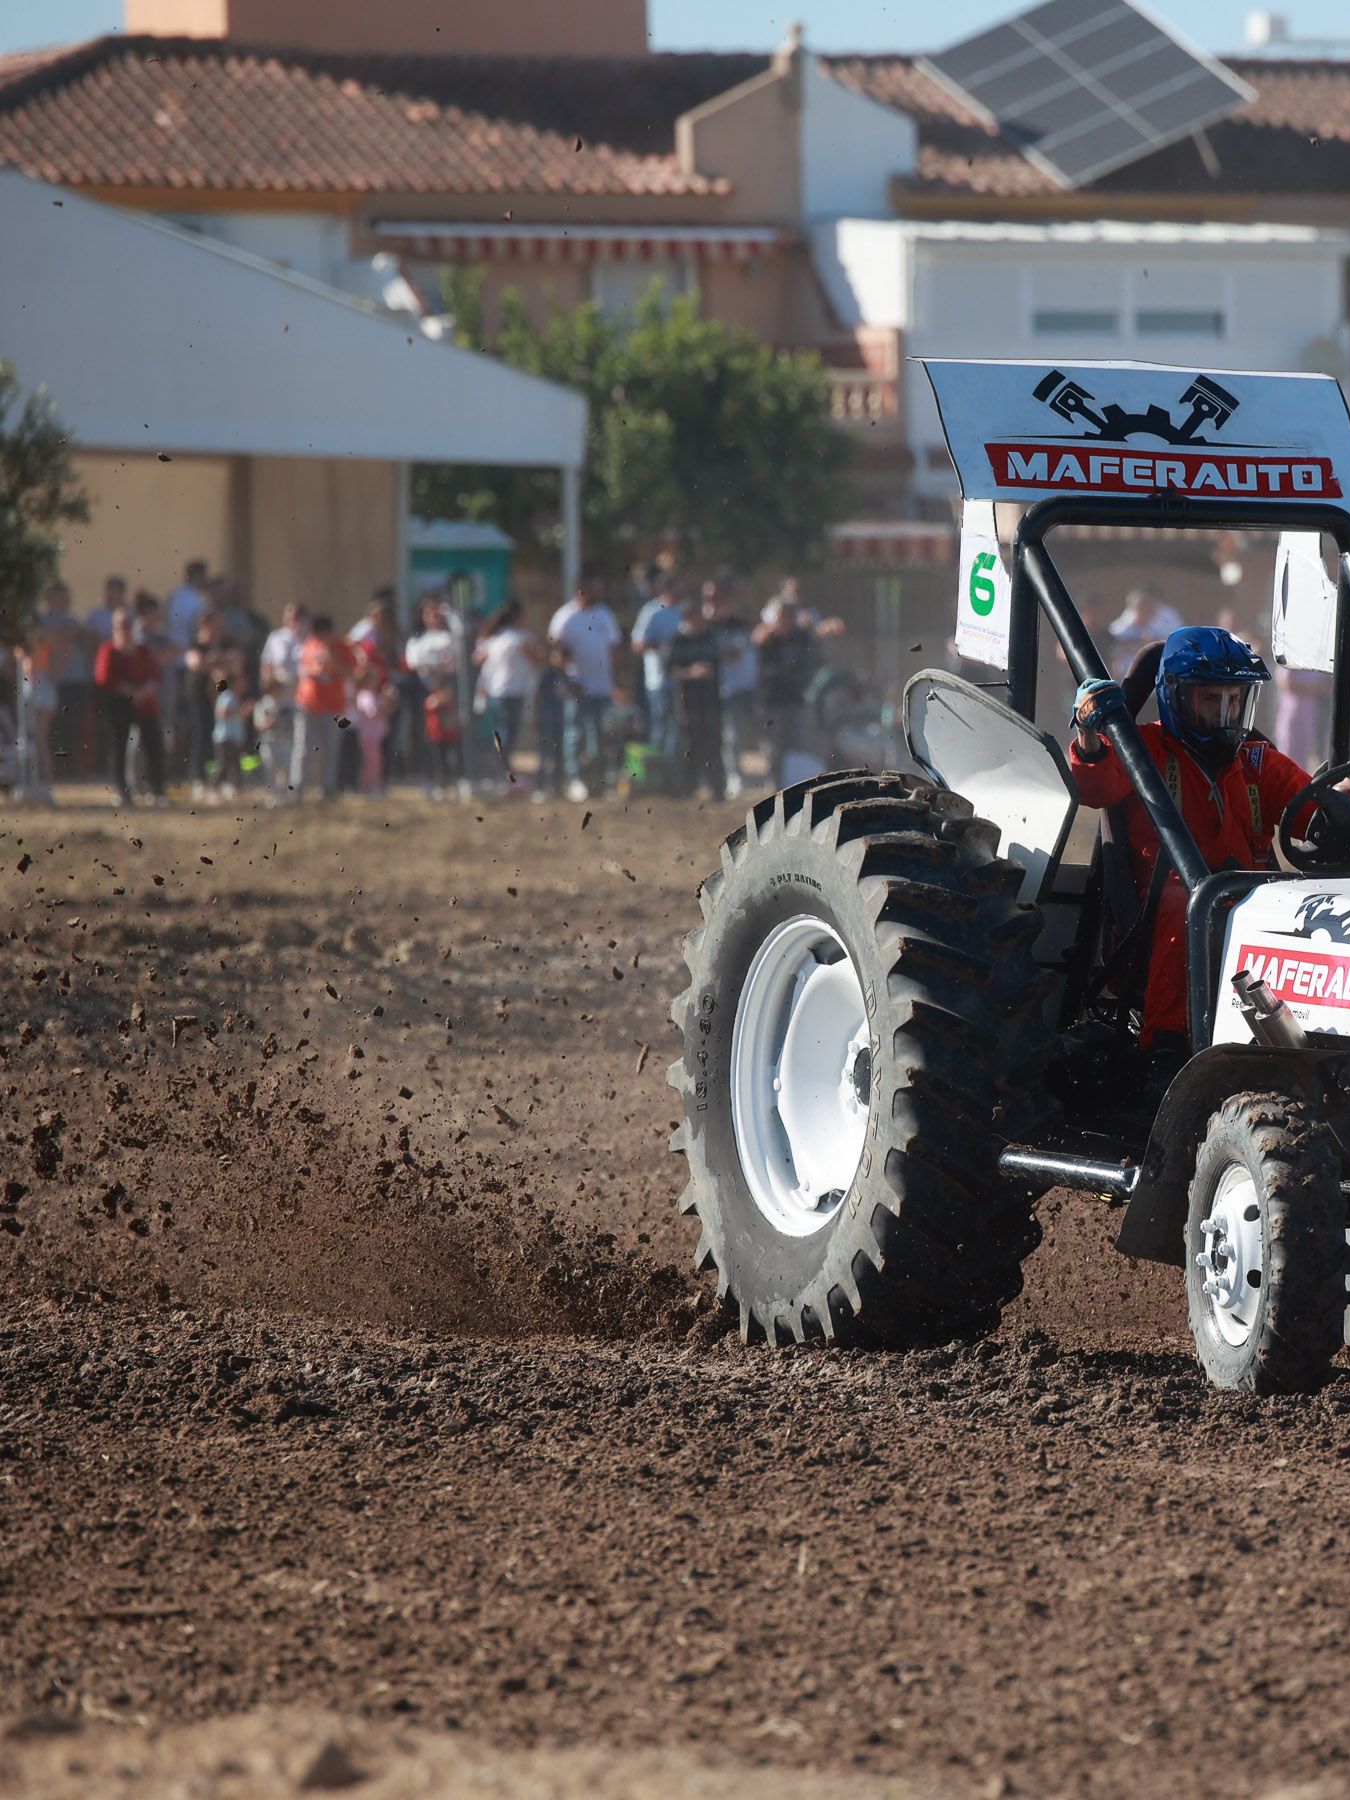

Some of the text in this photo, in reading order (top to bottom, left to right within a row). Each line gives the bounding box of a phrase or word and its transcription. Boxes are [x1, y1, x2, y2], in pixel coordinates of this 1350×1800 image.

[1006, 450, 1324, 492] MAFERAUTO
[969, 551, 997, 617] 6
[848, 979, 882, 1220] DAYTON
